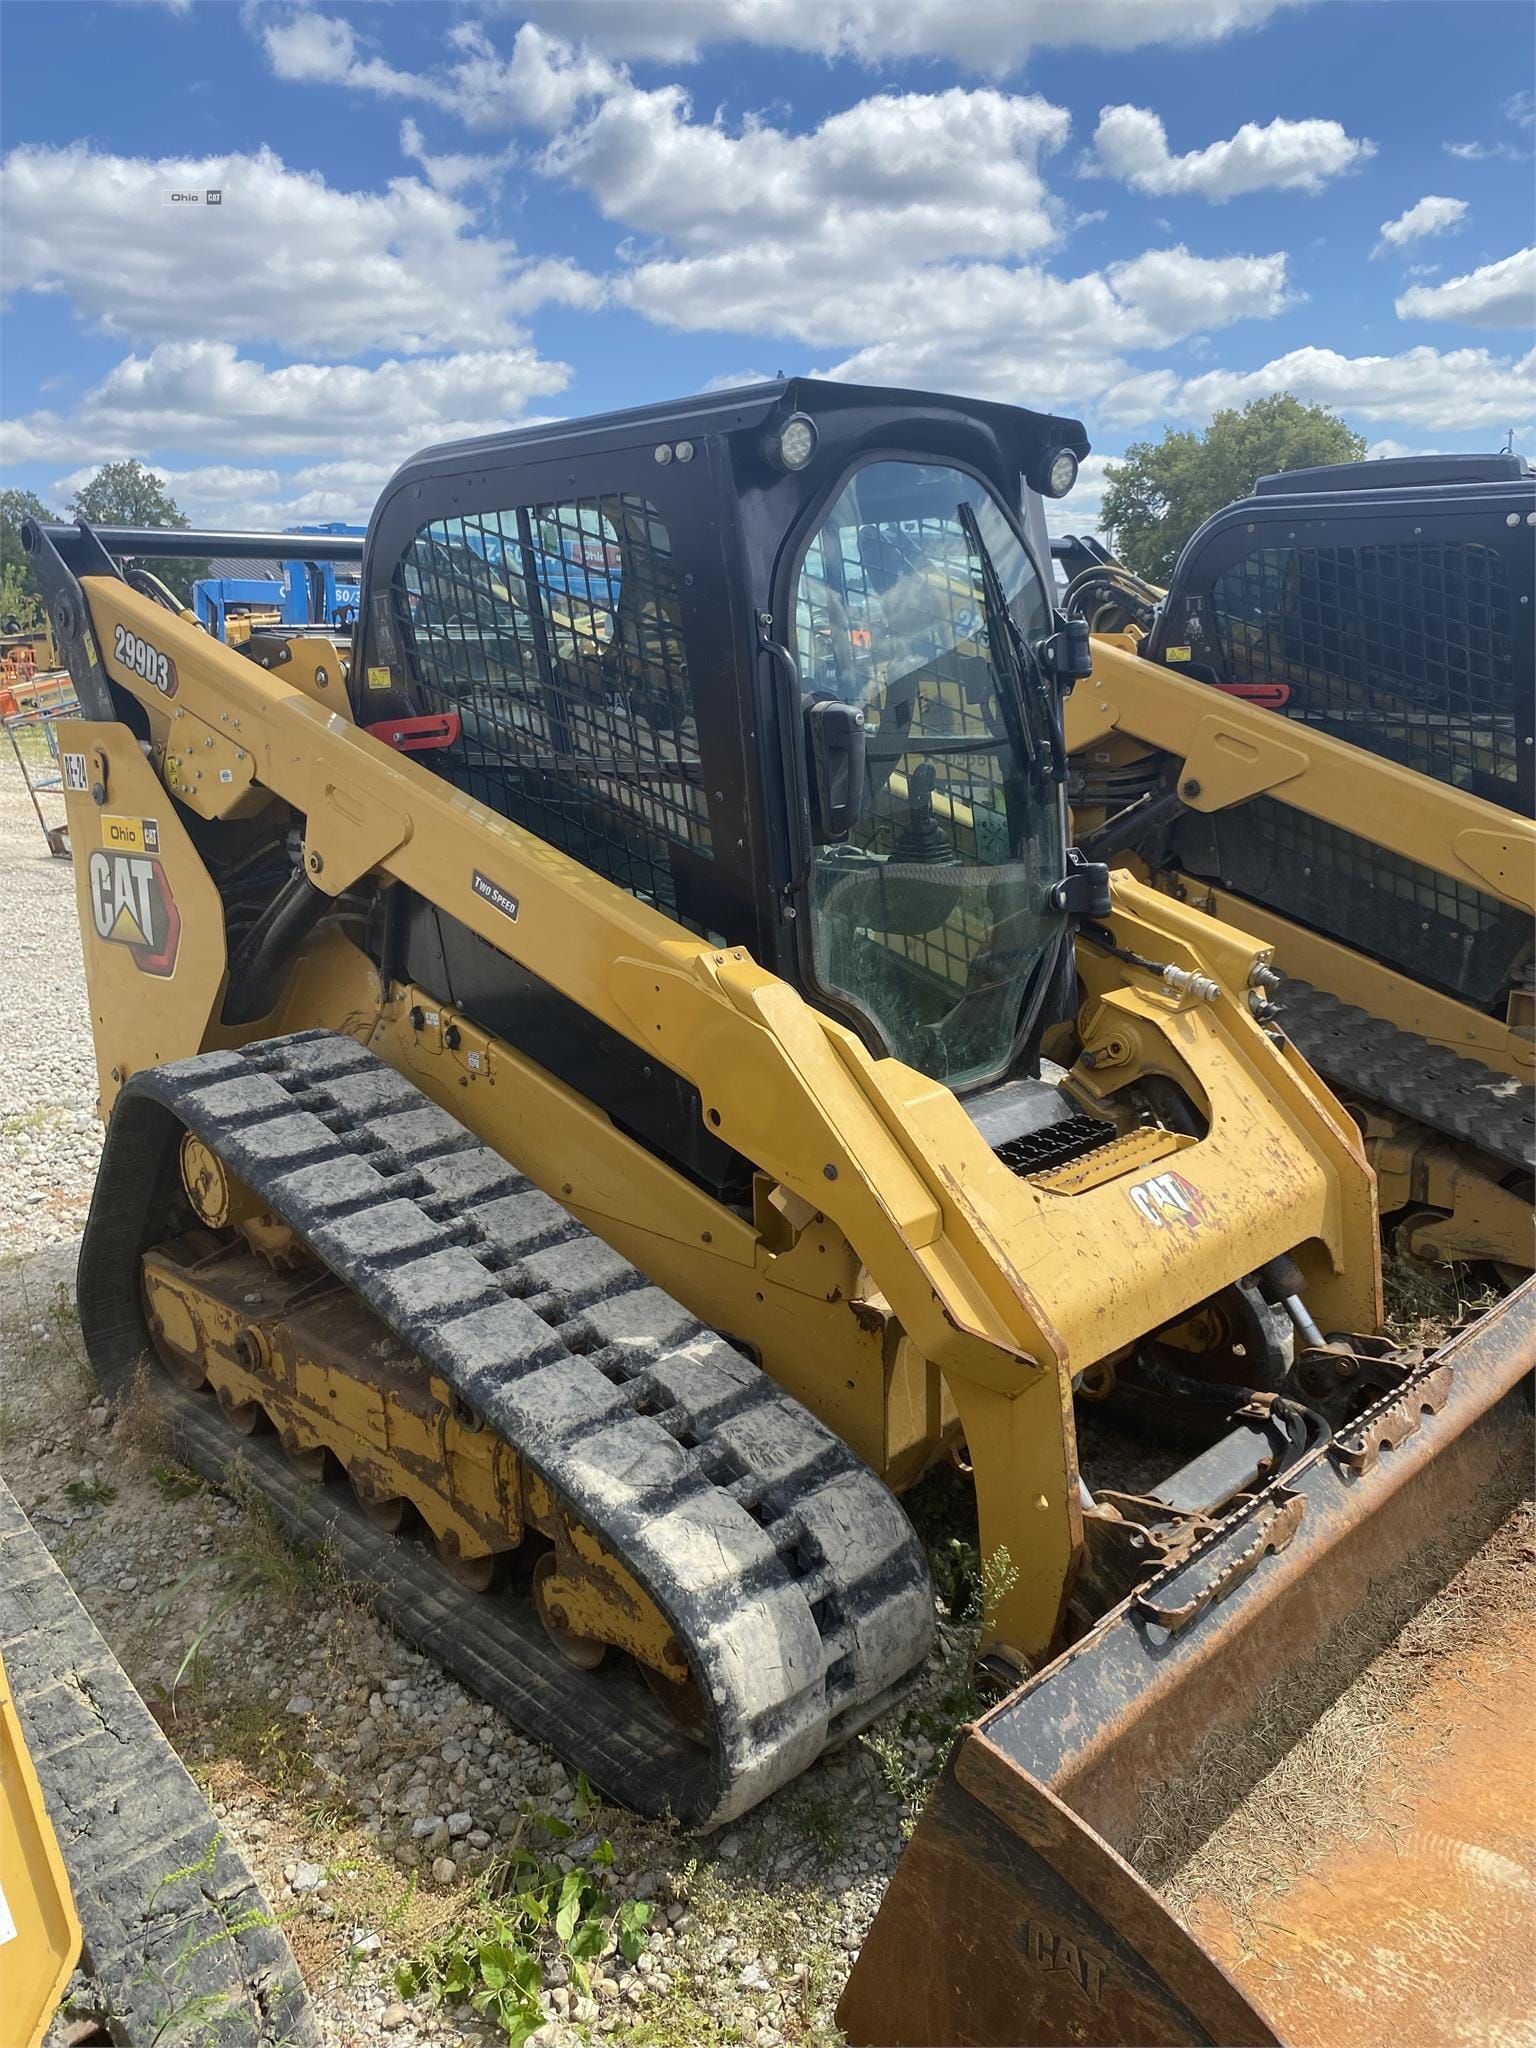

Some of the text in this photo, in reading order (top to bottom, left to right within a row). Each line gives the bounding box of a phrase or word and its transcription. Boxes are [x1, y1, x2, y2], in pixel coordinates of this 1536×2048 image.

[115, 625, 169, 692] 299D3
[64, 755, 88, 789] RE-24
[110, 825, 157, 845] Ohio CAT
[90, 852, 155, 947] CAT
[1130, 1173, 1194, 1228] CAT
[1026, 1918, 1107, 2003] CAT
